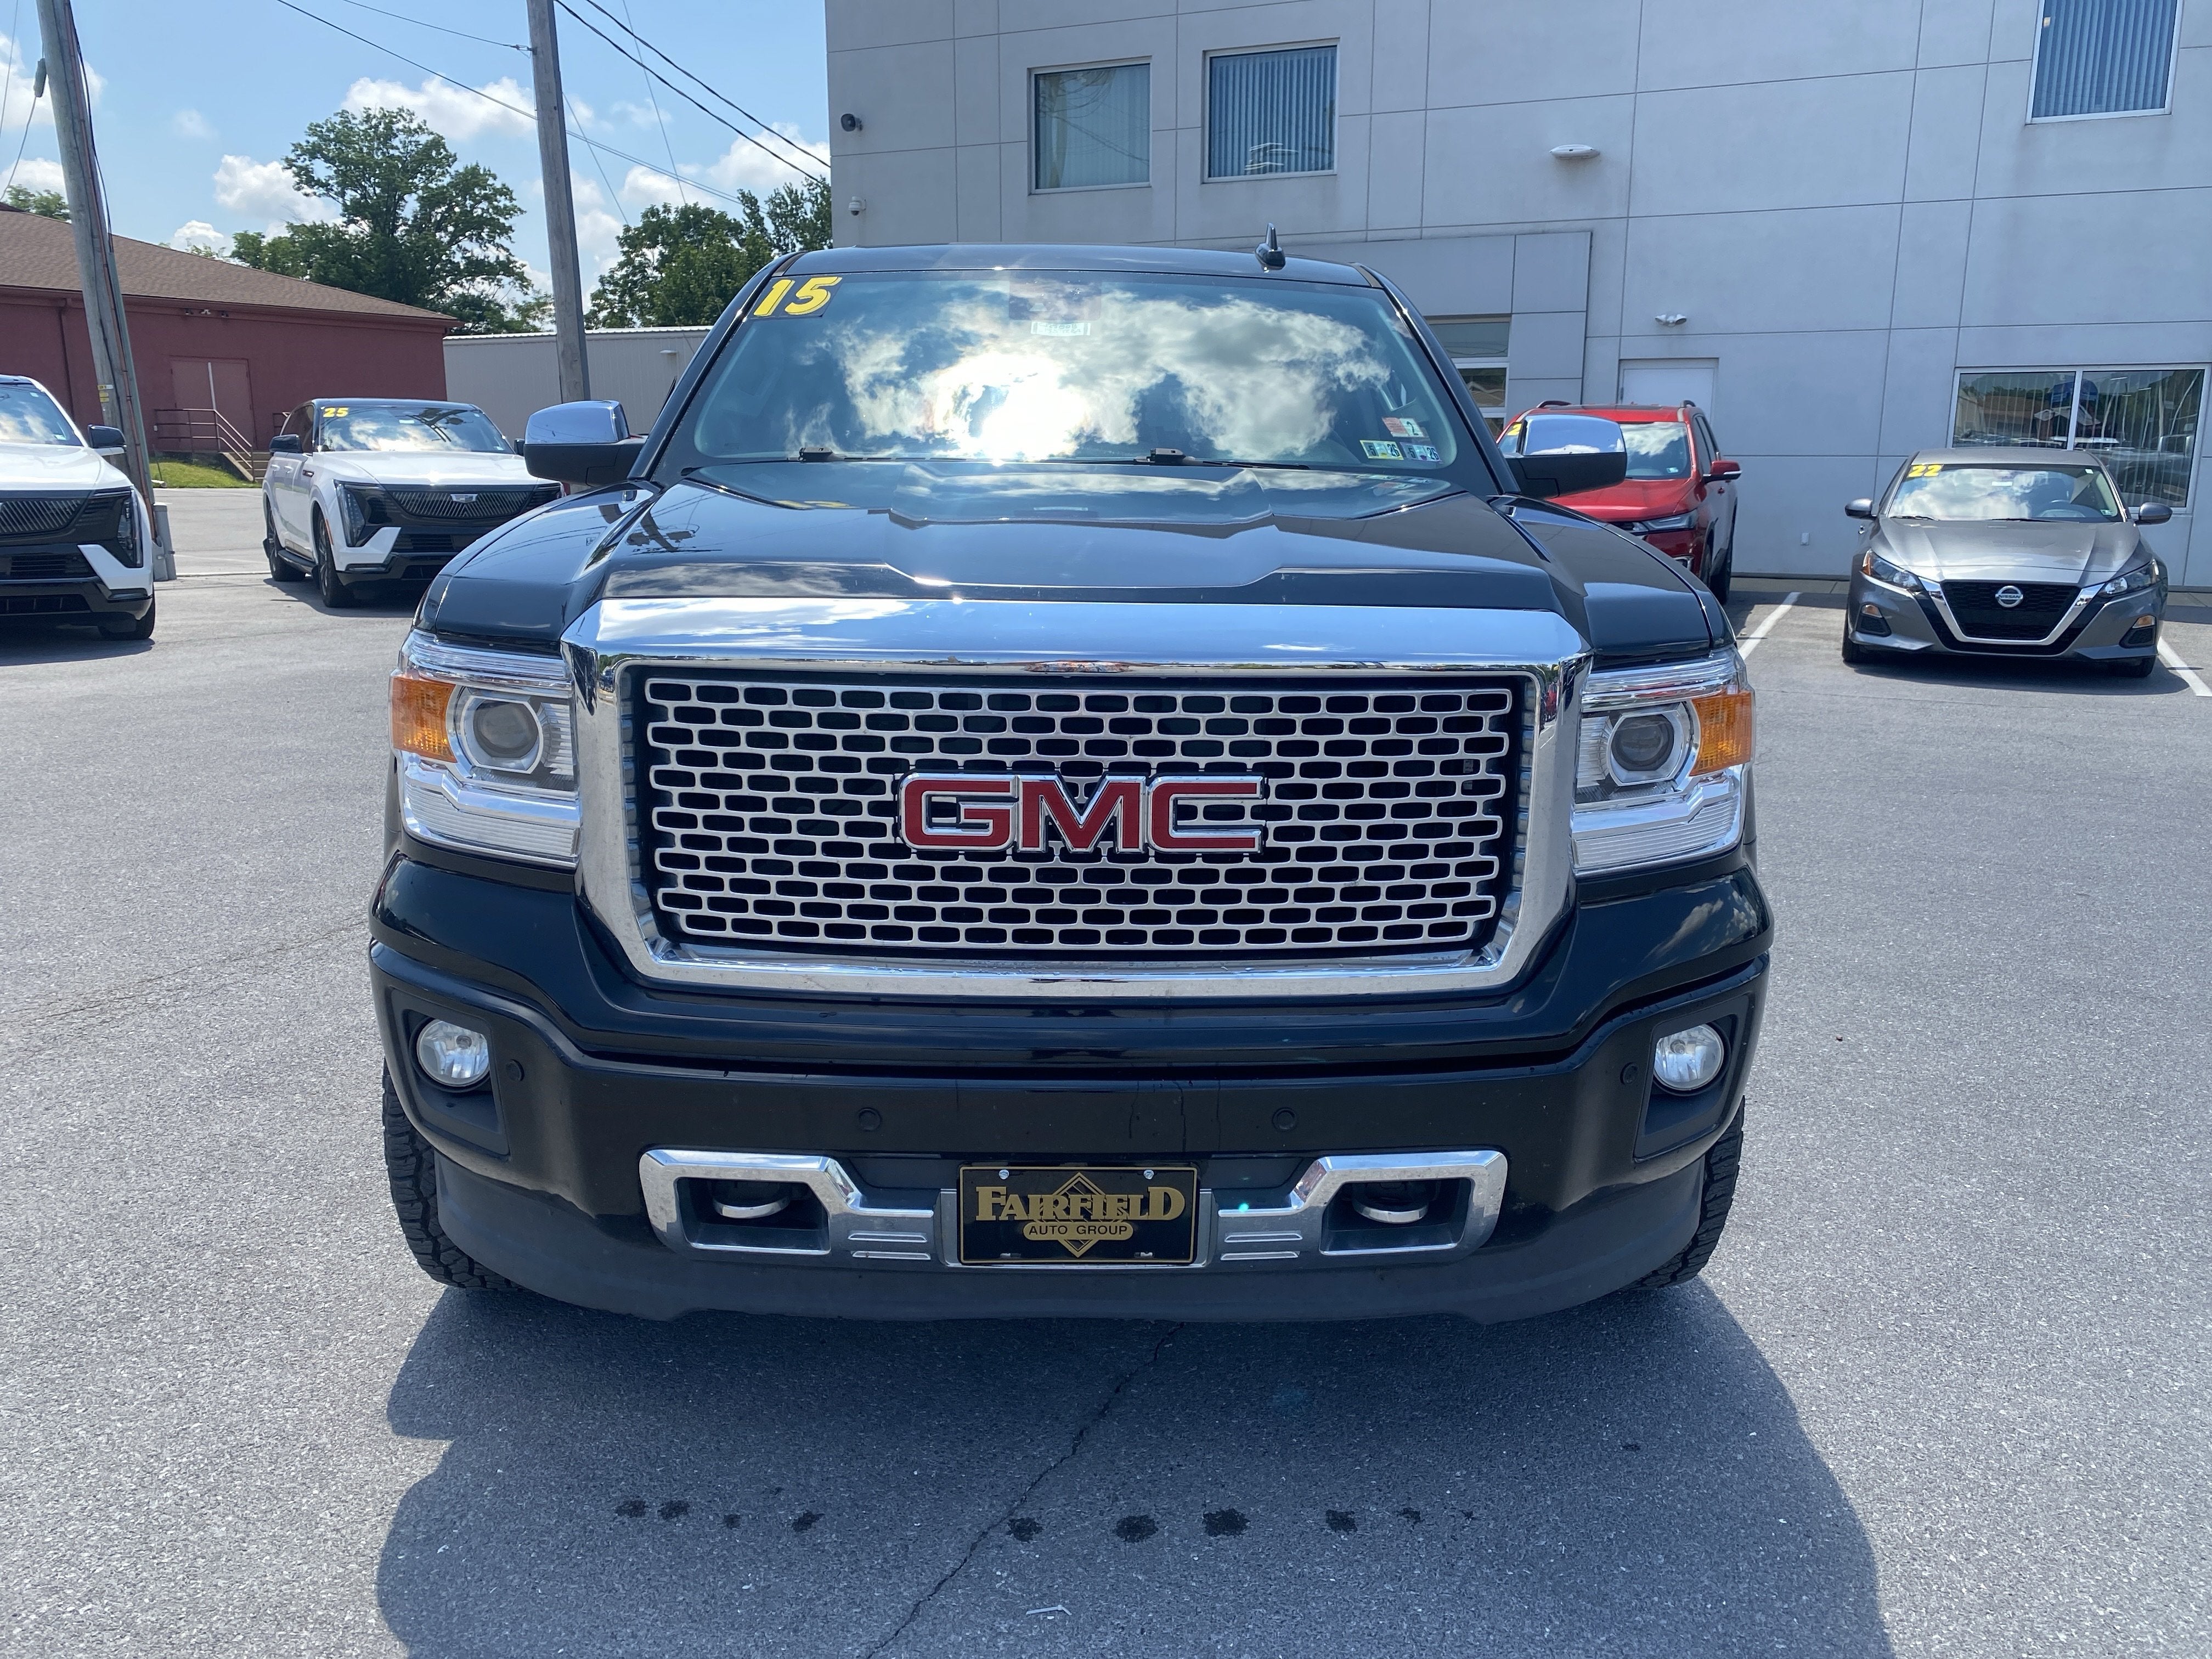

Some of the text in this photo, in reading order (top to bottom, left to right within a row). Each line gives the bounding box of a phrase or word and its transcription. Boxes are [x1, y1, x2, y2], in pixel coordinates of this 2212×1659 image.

[754, 276, 843, 317] 15
[323, 407, 349, 417] 25
[1406, 421, 1419, 436] 2
[1507, 424, 1522, 436] 2
[1369, 443, 1400, 457] 5 26
[1408, 447, 1440, 461] 5 26
[1908, 465, 1942, 477] 22
[899, 772, 1263, 854] GMC
[975, 1186, 1186, 1221] FAIRFIELD
[1028, 1225, 1128, 1236] AUTO GROUP
